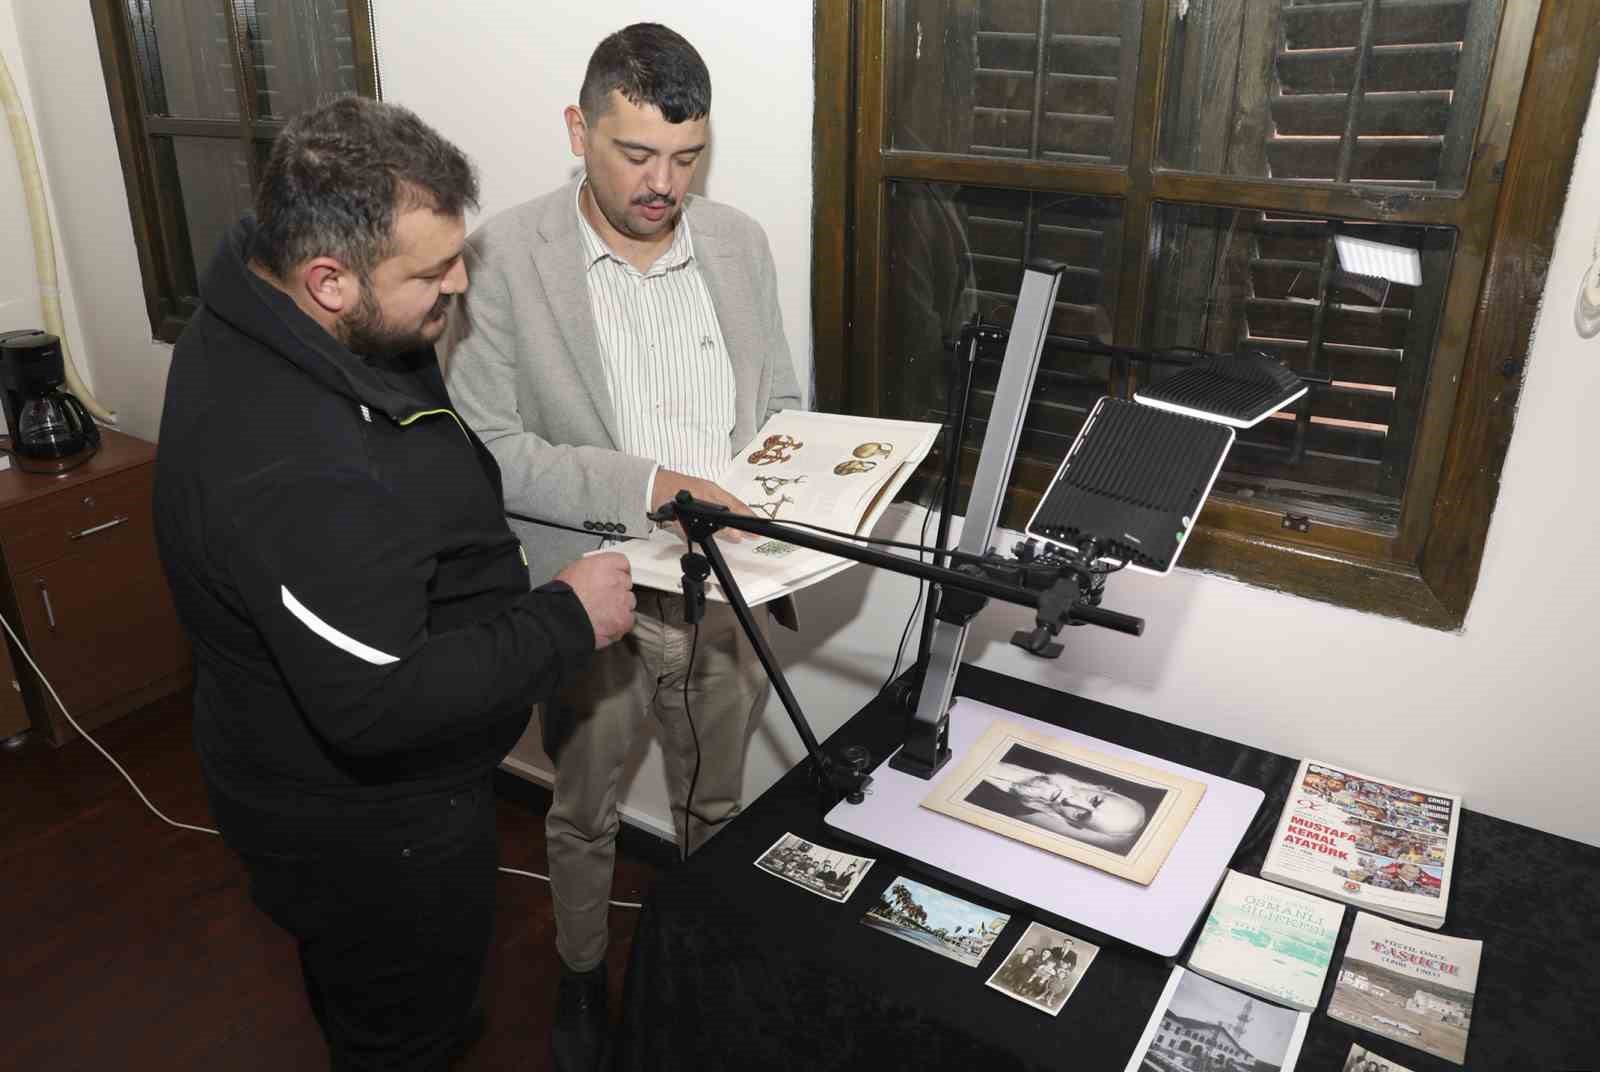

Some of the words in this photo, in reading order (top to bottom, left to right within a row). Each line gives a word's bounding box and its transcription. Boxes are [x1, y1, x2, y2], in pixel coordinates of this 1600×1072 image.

[1288, 825, 1337, 847] KEMAL
[1291, 815, 1357, 843] MUSTAFA
[1283, 834, 1349, 861] ATATÜRK
